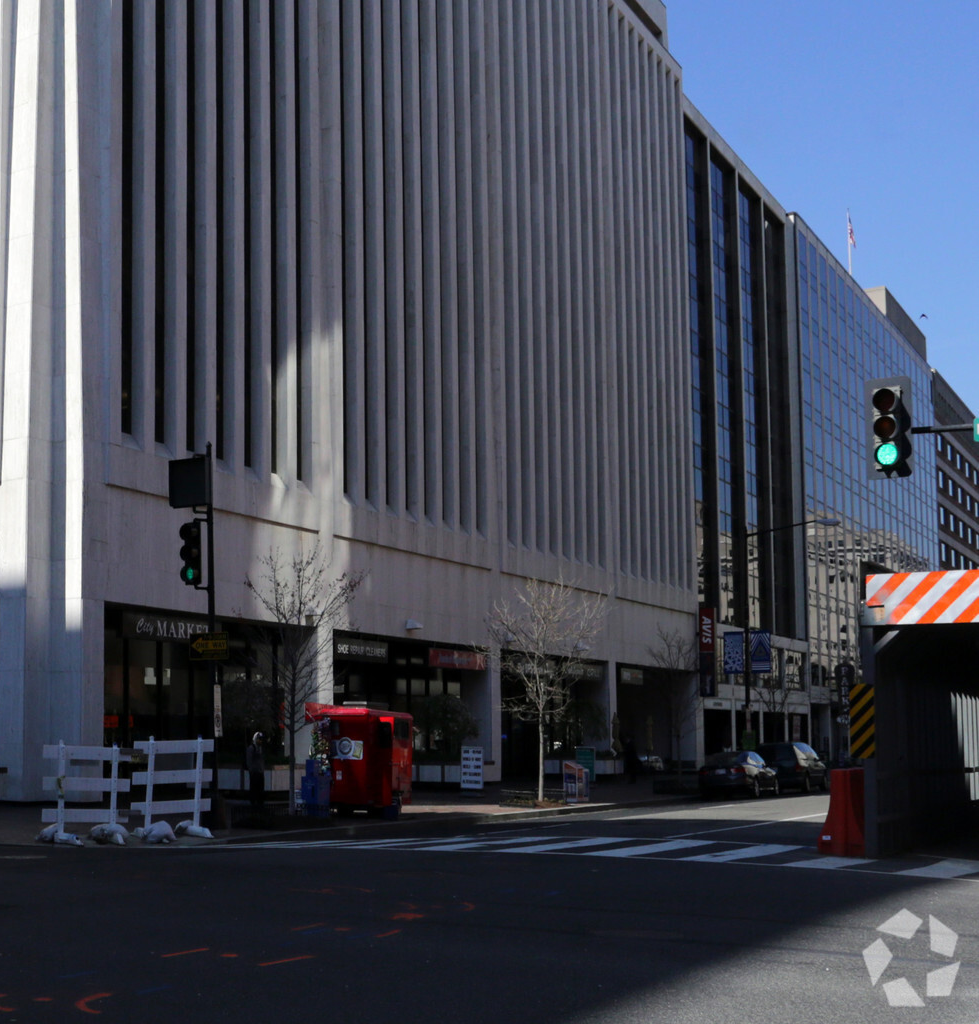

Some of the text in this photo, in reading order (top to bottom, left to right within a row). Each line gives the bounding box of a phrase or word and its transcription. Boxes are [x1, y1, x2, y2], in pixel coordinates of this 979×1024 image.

[135, 617, 154, 636] City
[701, 615, 712, 645] AVIS
[196, 640, 225, 649] ONE WAY
[337, 643, 350, 654] SHOE
